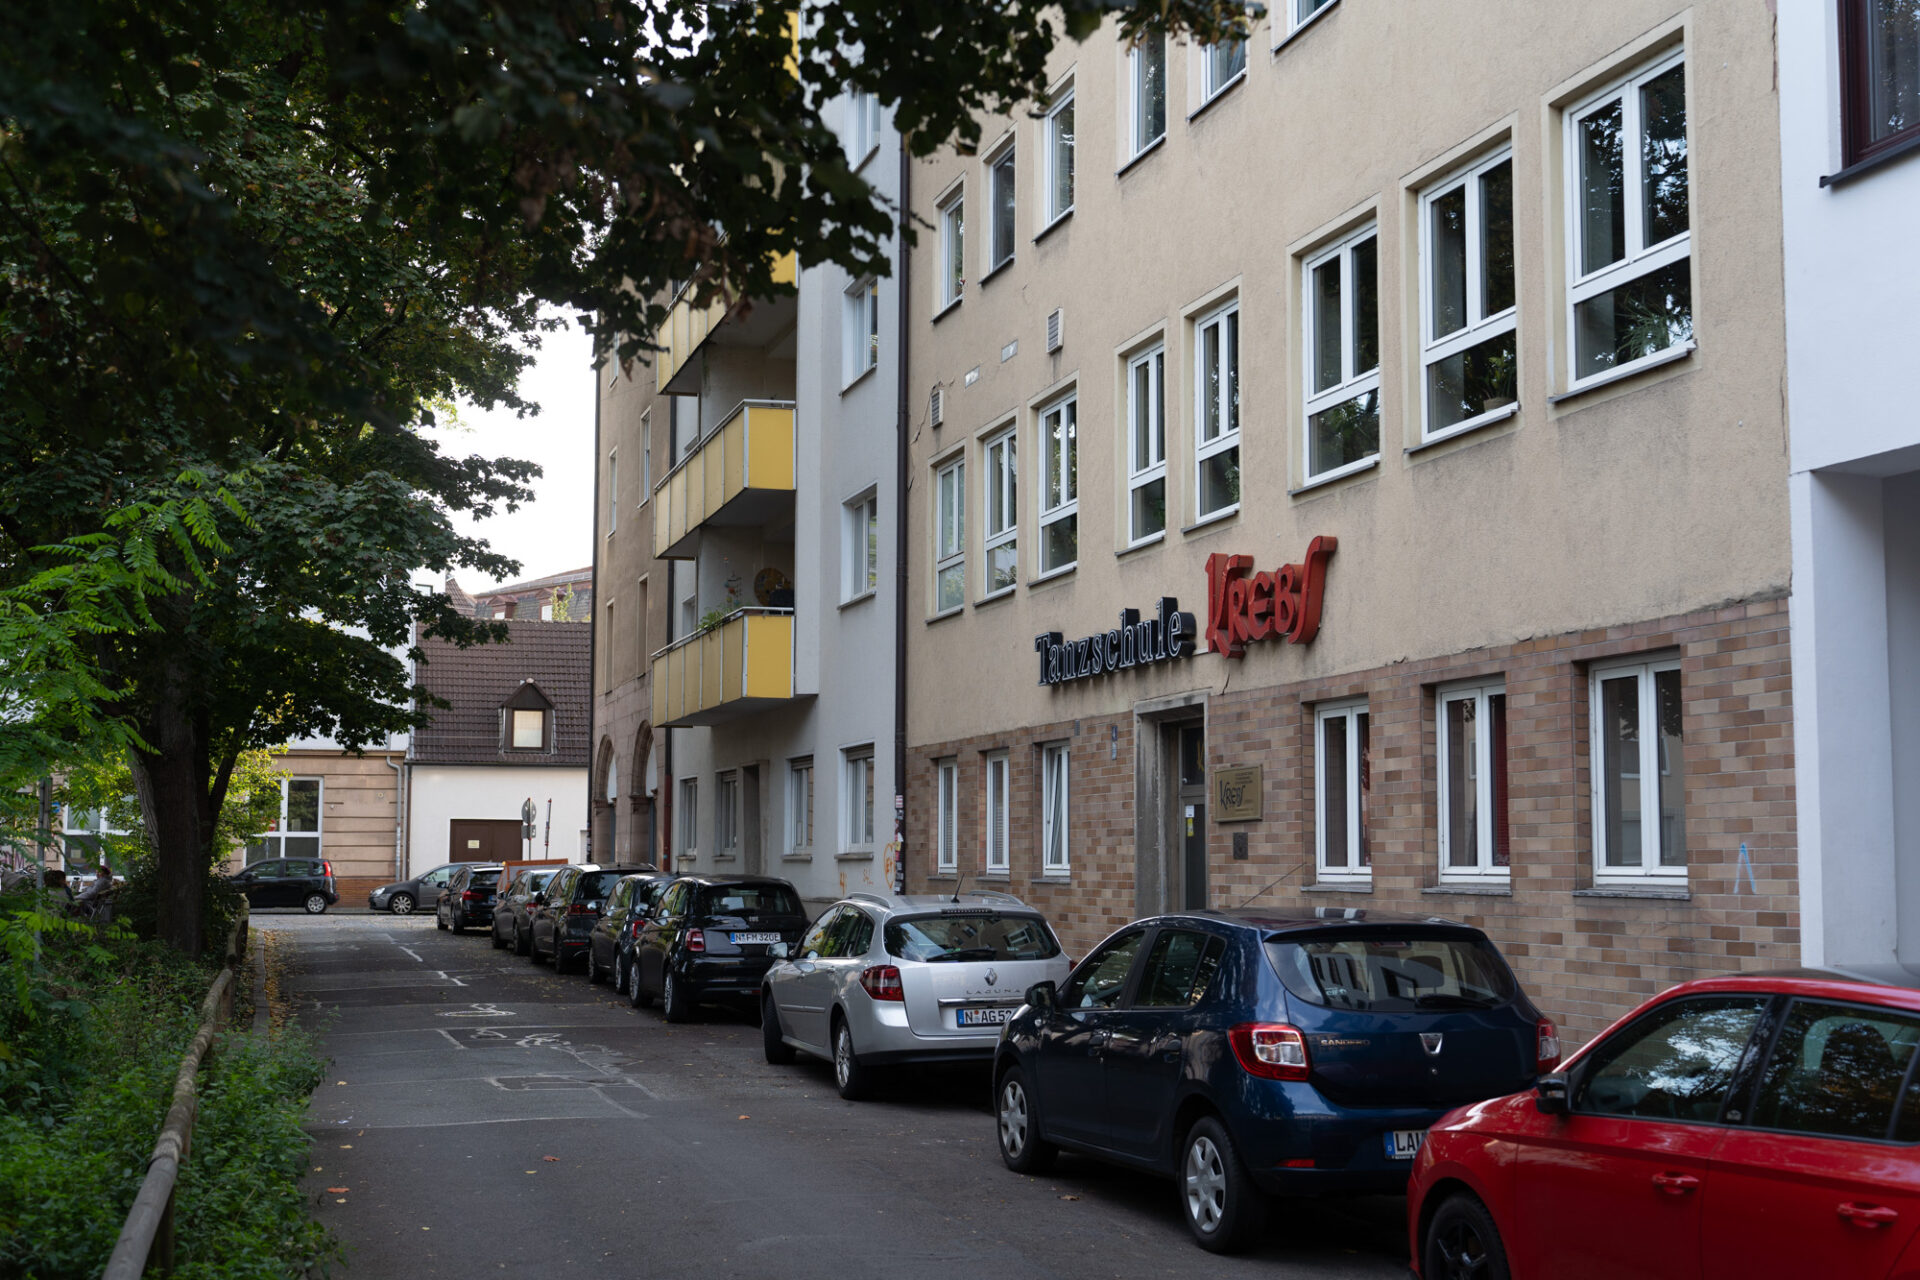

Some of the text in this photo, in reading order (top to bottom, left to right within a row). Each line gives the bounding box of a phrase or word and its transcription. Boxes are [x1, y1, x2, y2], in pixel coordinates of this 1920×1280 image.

[1034, 535, 1338, 686] Tanzschule KREBS
[964, 1010, 973, 1024] N
